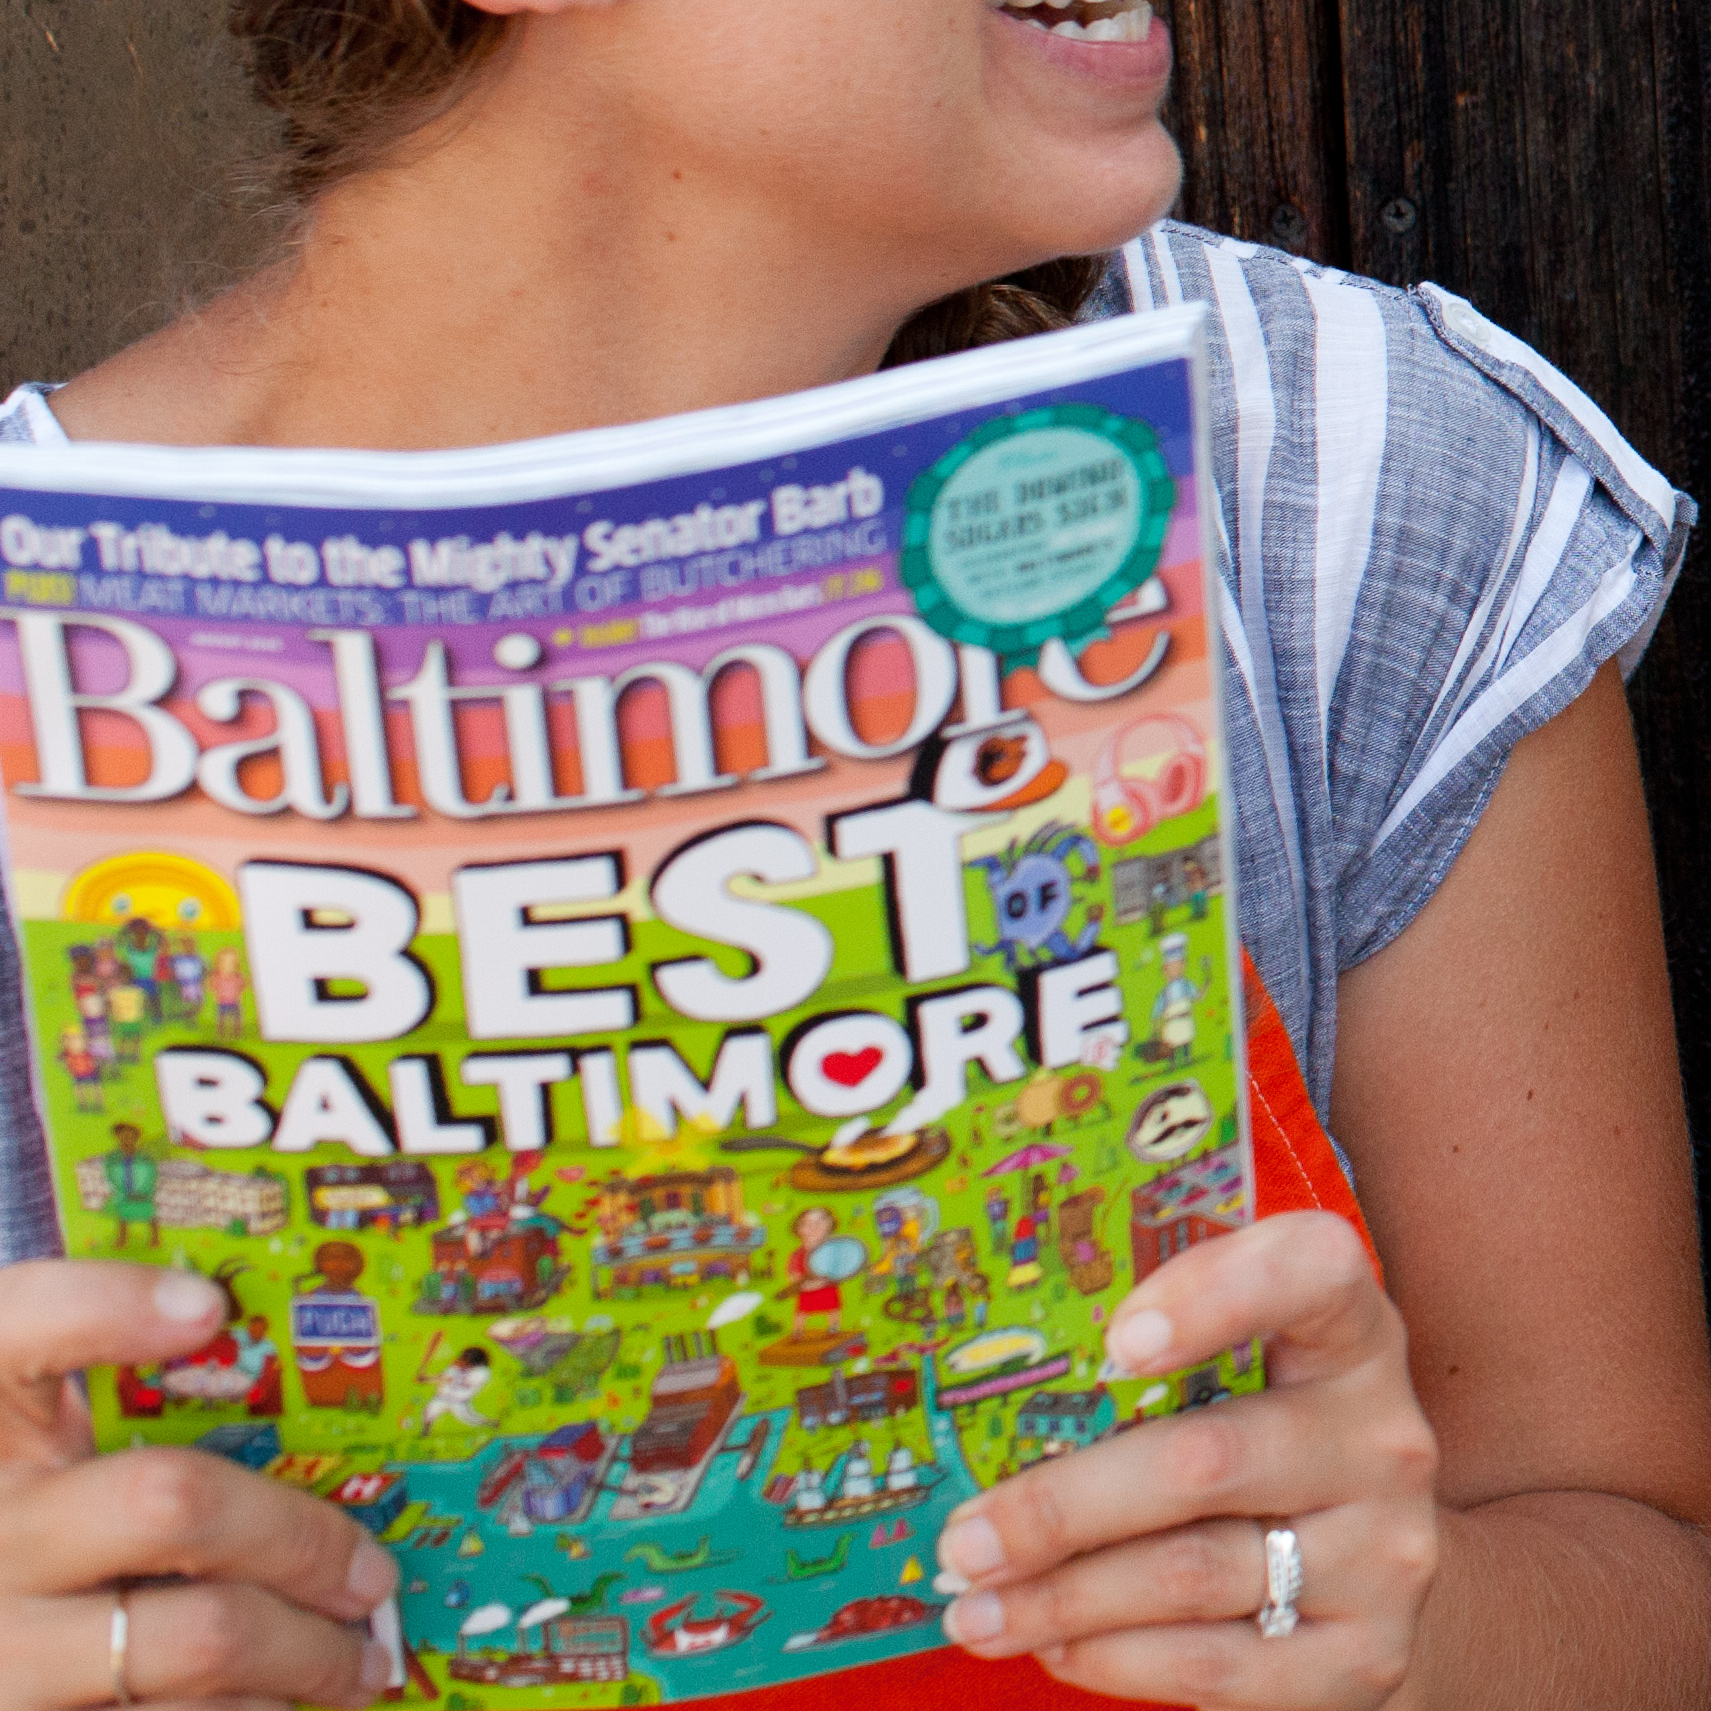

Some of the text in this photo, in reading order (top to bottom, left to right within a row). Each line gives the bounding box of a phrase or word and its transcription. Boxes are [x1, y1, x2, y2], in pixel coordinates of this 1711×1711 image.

[0, 465, 886, 594] Our Tribute to the Mighty Senator Barb
[78, 571, 187, 613] MEAT
[398, 589, 481, 626] THE
[485, 584, 566, 624] ART
[573, 571, 635, 613] OF
[636, 516, 889, 605] BUTCHERING
[238, 793, 1010, 1045] BEST
[1003, 877, 1060, 922] OF
[152, 944, 1132, 1157] BALTIMORE
